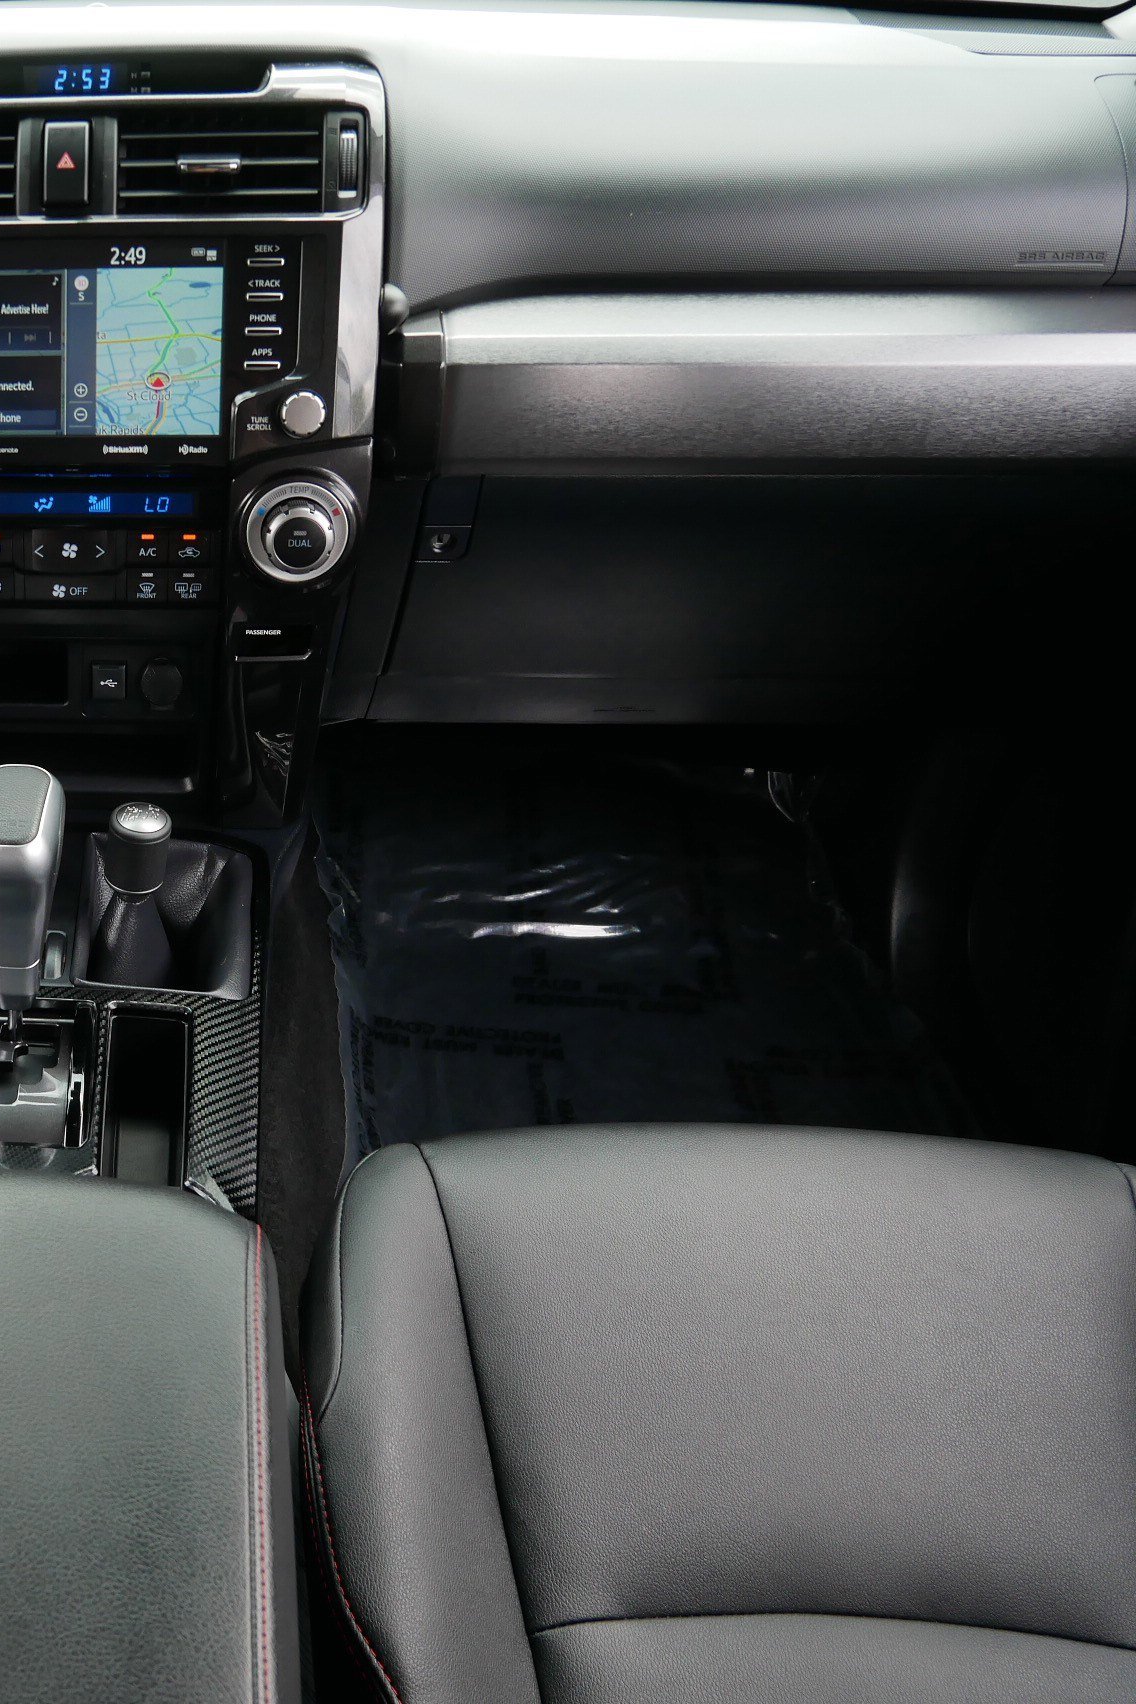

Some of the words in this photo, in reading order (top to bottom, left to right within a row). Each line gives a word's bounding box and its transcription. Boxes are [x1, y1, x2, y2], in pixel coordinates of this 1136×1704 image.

[54, 69, 111, 90] 2:53
[110, 247, 146, 265] 2:49
[254, 280, 280, 288] TRACK
[1, 304, 30, 315] Advertise
[30, 303, 49, 315] Here!
[249, 314, 277, 323] PHONE
[251, 348, 273, 357] APPS
[127, 390, 138, 401] St
[140, 390, 171, 401] Cloud
[251, 416, 269, 424] TUNE
[111, 425, 144, 436] Rapids
[247, 423, 272, 431] SCROLL
[290, 486, 310, 494] TEMP
[144, 496, 170, 512] LO
[287, 539, 312, 547] DUAL
[138, 547, 157, 558] A/C
[69, 586, 88, 596] OFF
